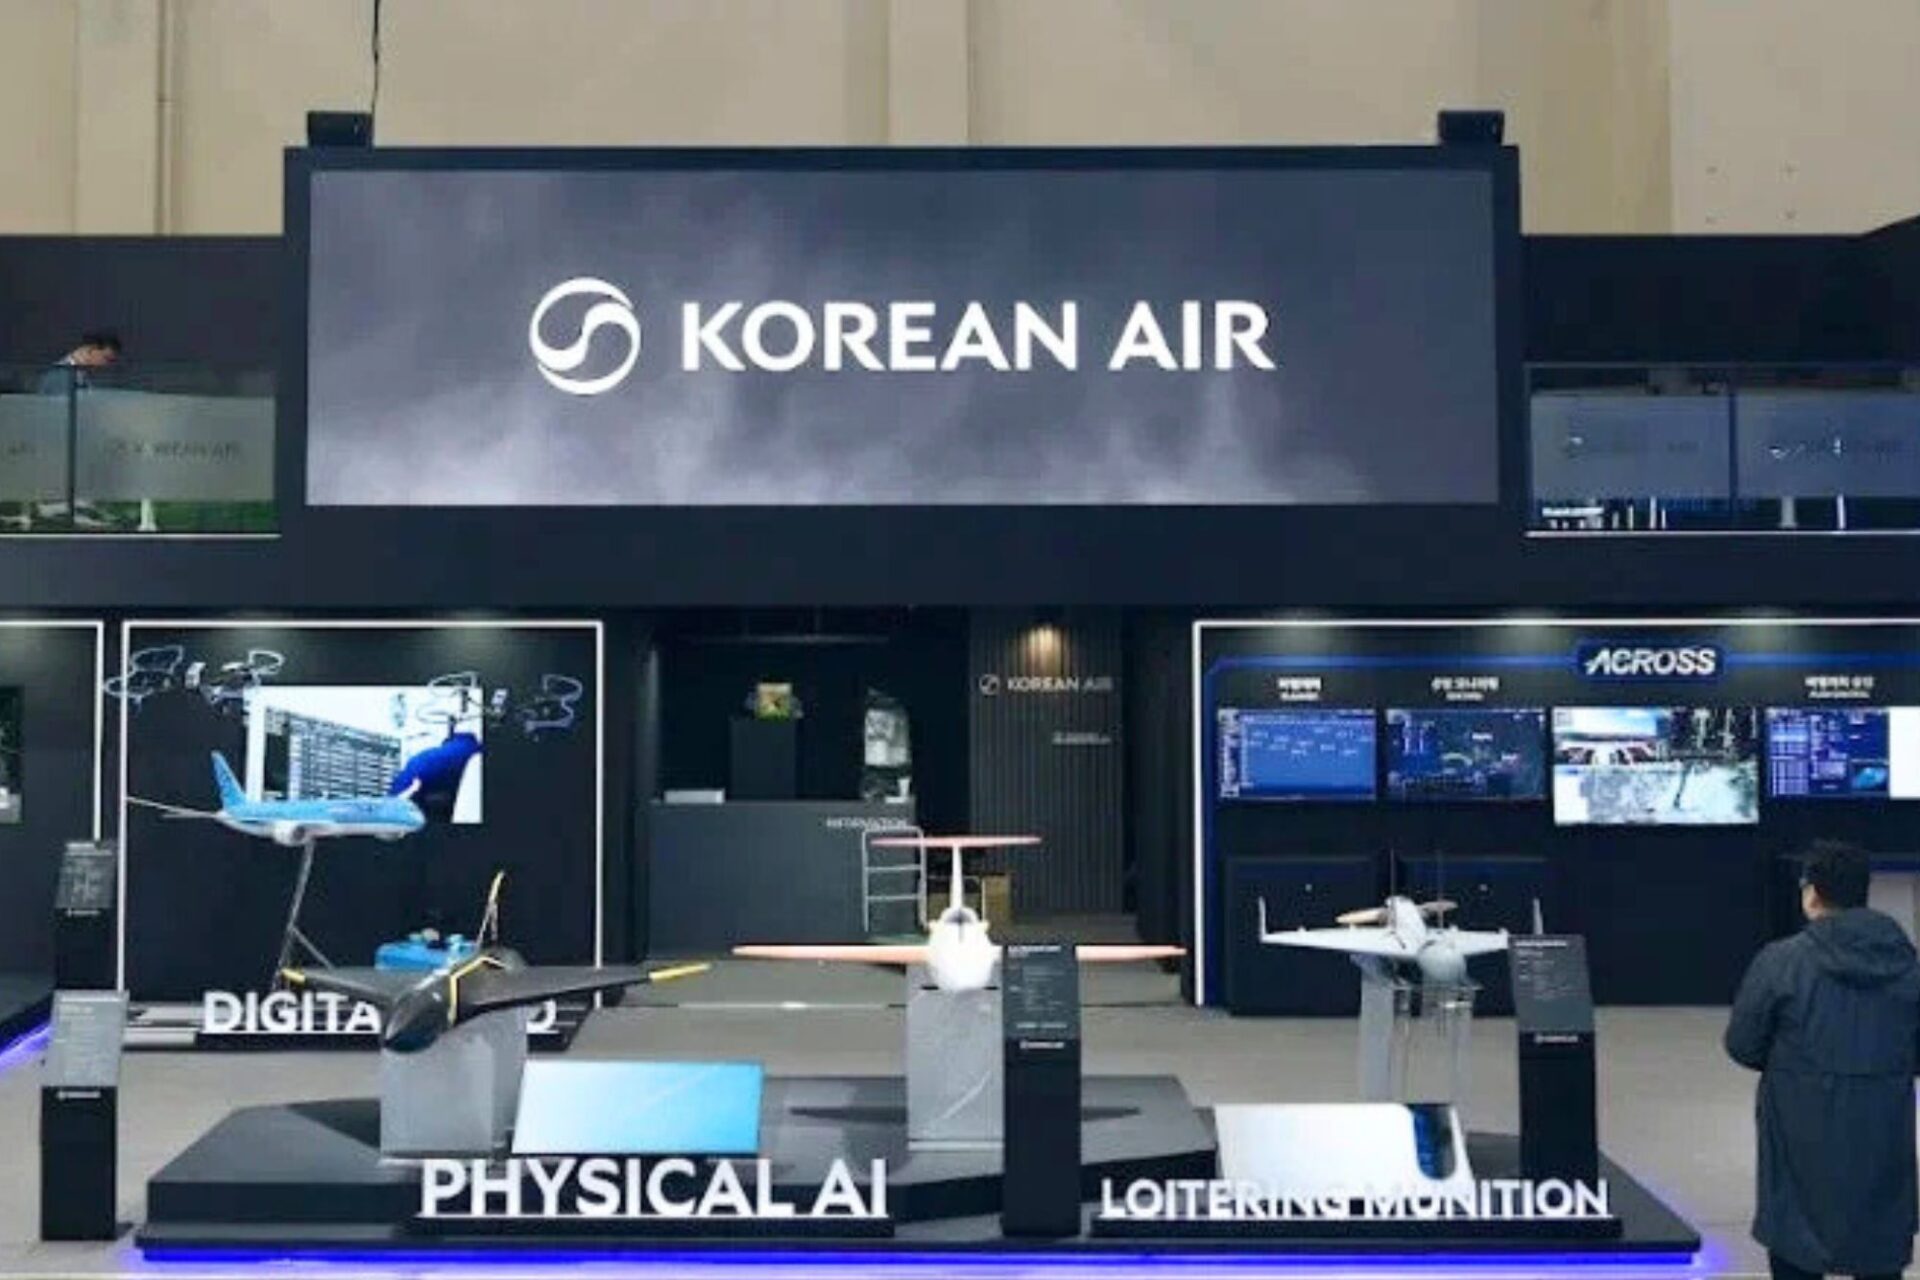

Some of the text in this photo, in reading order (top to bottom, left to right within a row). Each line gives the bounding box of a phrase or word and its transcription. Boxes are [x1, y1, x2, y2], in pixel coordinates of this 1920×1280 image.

[682, 300, 1277, 371] KOREAN AIR
[1584, 648, 1717, 676] ACROSS
[1006, 676, 1079, 693] KOREAN
[204, 991, 382, 1033] DIGITA
[421, 1158, 888, 1217] PHYSICAL AI
[1102, 1177, 1608, 1219] LOITERING MUNITION
